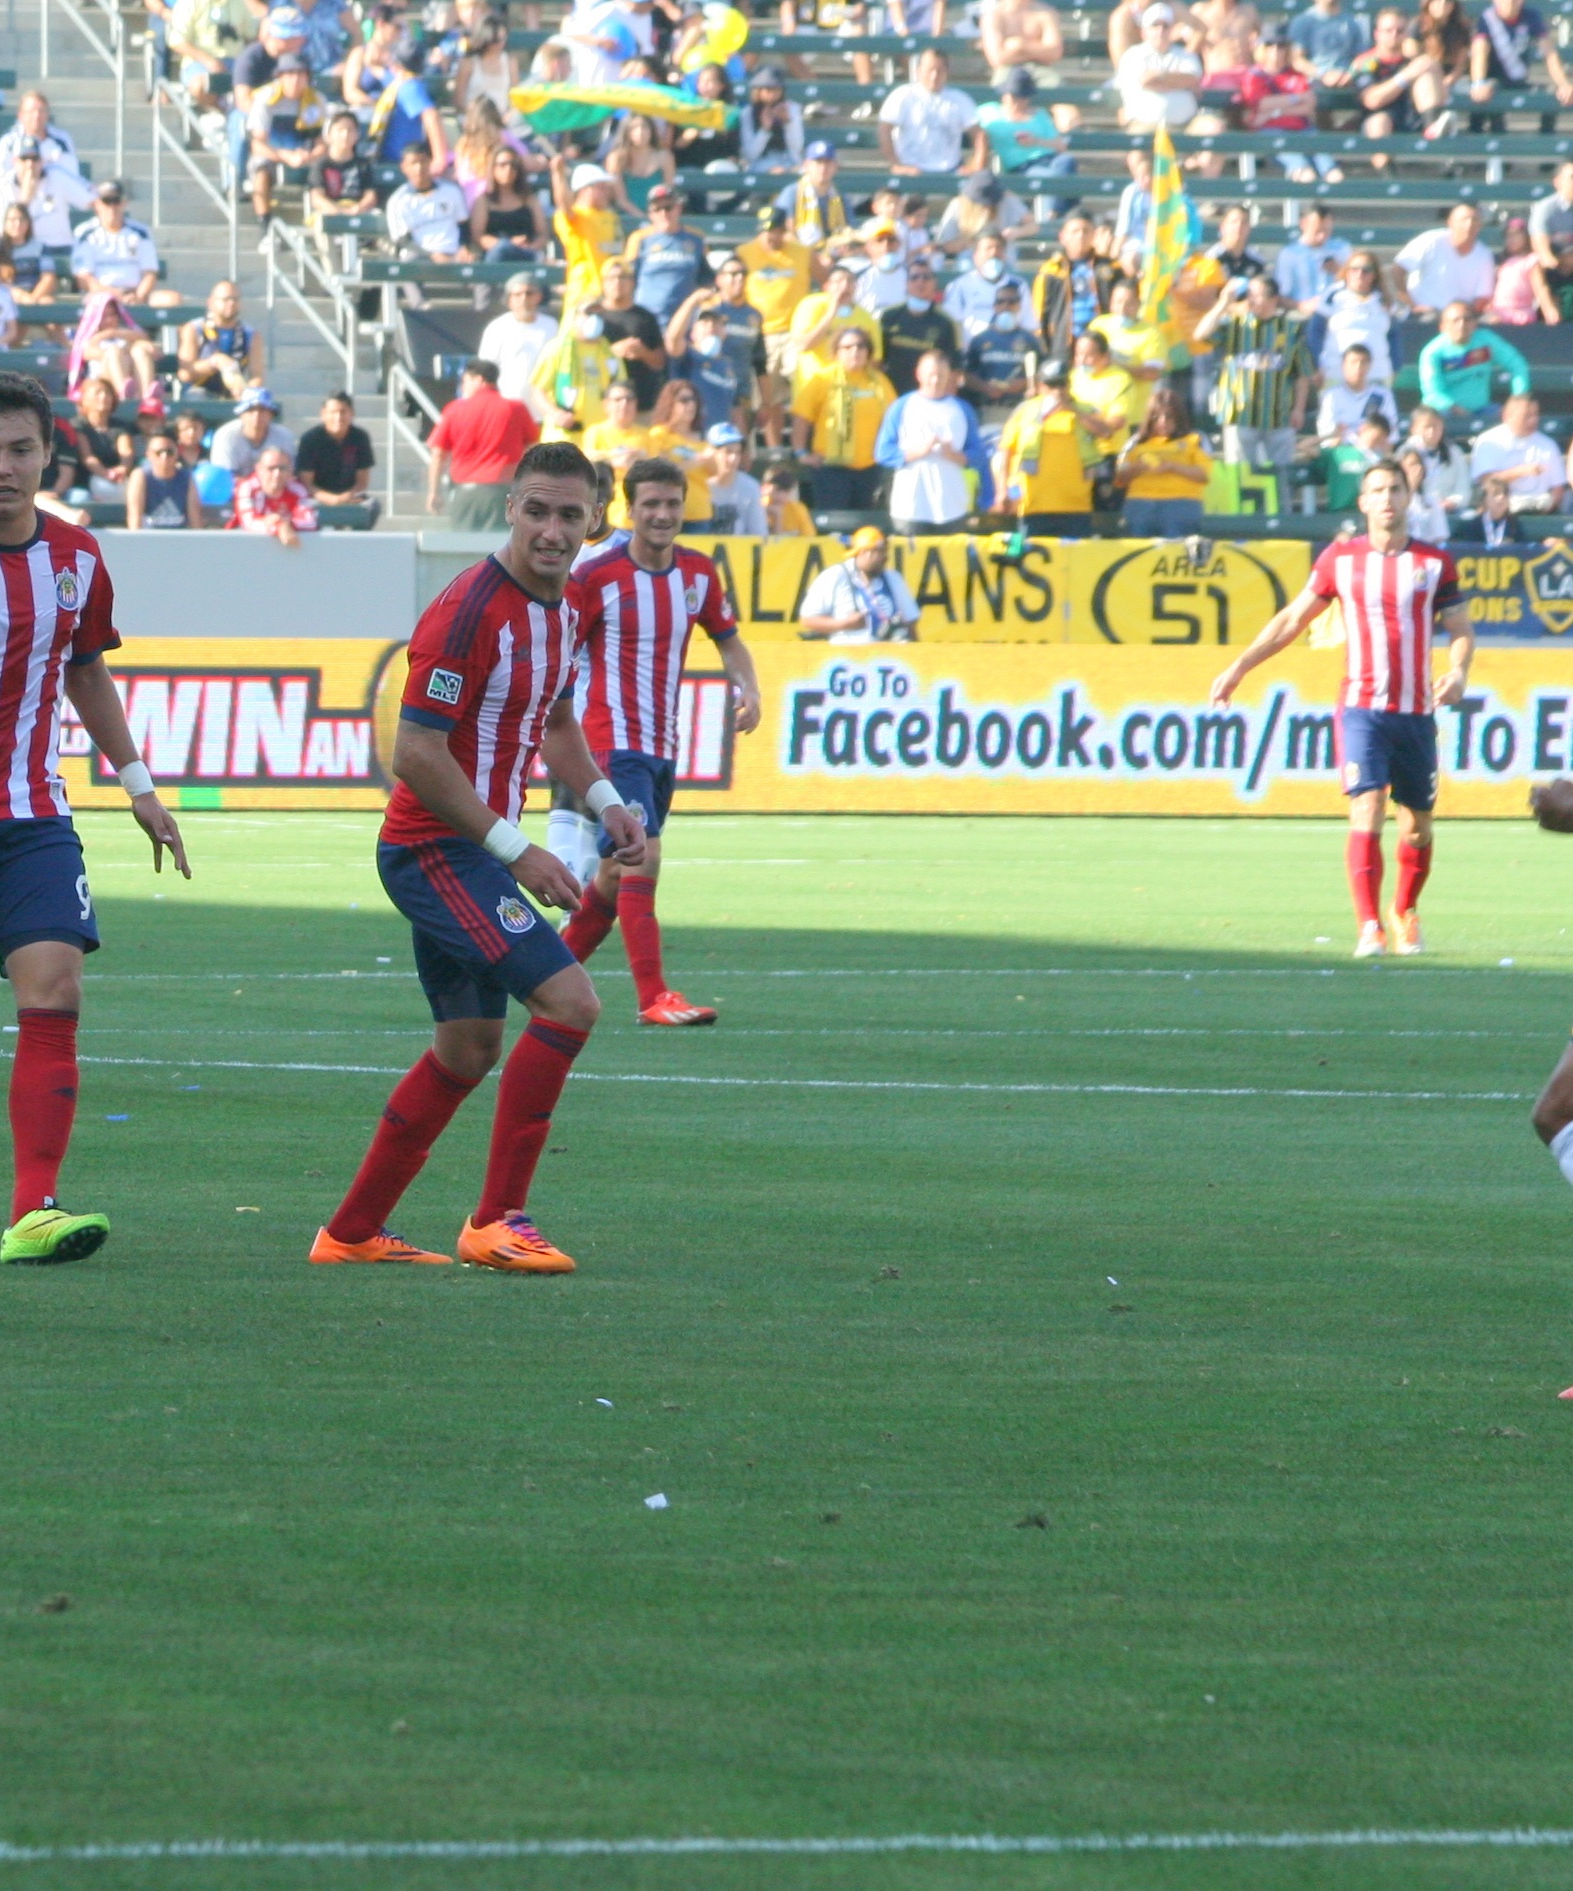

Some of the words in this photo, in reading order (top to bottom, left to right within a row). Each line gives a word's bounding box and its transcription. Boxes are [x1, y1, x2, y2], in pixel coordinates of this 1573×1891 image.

[712, 542, 1054, 623] ALAANS
[1456, 556, 1521, 592] CUP
[1151, 584, 1229, 645] 51
[1467, 596, 1523, 623] ONS
[429, 688, 457, 702] MLS
[830, 666, 867, 698] Go
[878, 666, 909, 698] To
[789, 687, 1338, 791] Facebook.com/m
[1449, 697, 1517, 772] To
[1535, 697, 1573, 771] E
[76, 874, 91, 920] 9
